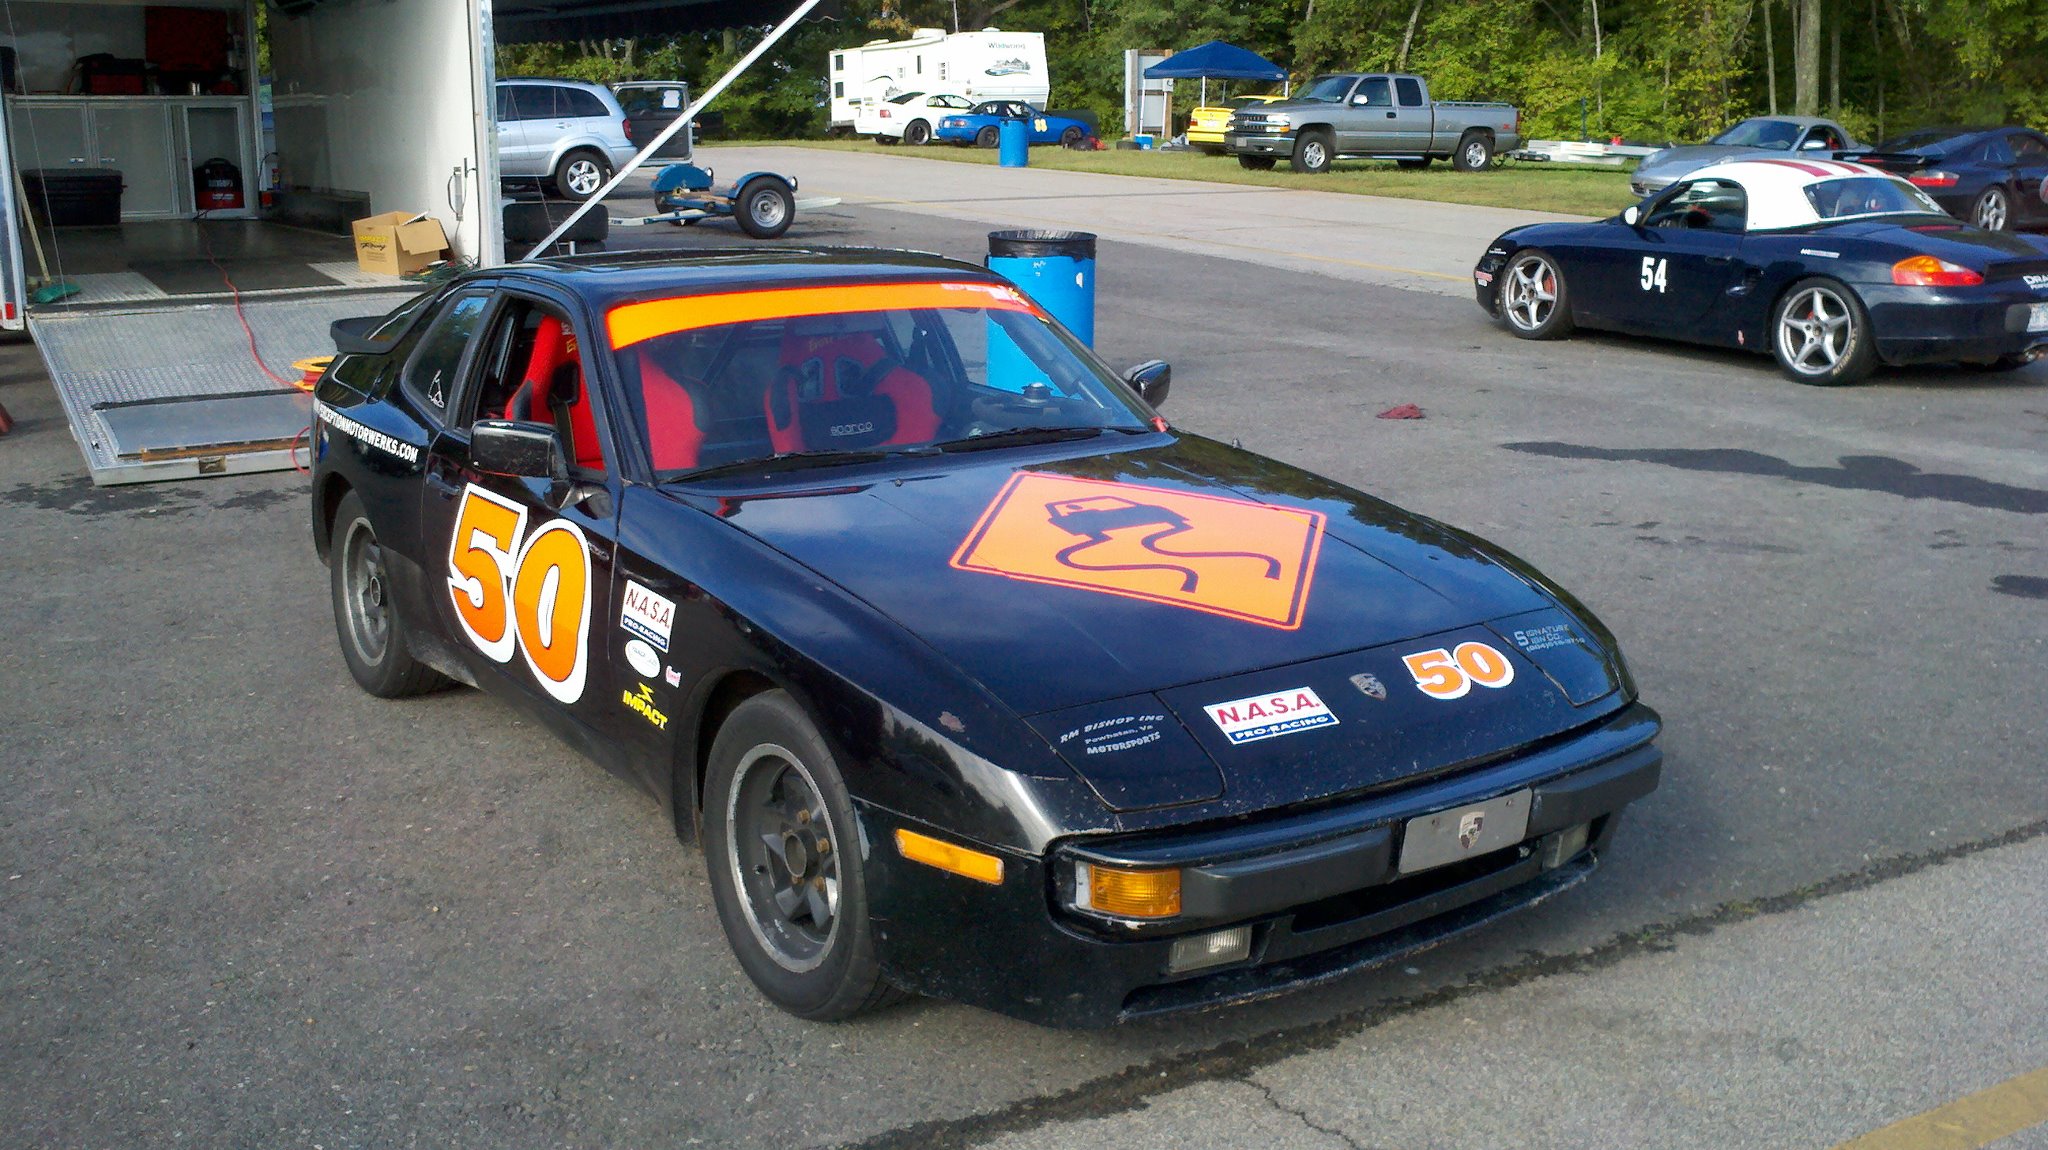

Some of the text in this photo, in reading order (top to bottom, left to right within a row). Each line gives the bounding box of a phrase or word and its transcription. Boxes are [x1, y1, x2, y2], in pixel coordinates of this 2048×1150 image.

[1640, 256, 1667, 293] 54
[831, 421, 873, 435] sparco
[448, 482, 592, 704] 50
[625, 587, 670, 629] N.A.S.A.
[624, 616, 667, 647] PRO-RACING
[1401, 641, 1514, 700] 50
[622, 689, 669, 730] IMPACT
[1216, 692, 1321, 725] N.A.S.A.
[1060, 728, 1080, 743] RM
[1083, 716, 1135, 733] BISHOP
[1086, 731, 1161, 755] MOTORSPORTS
[1235, 716, 1329, 740] PRO-RACING
